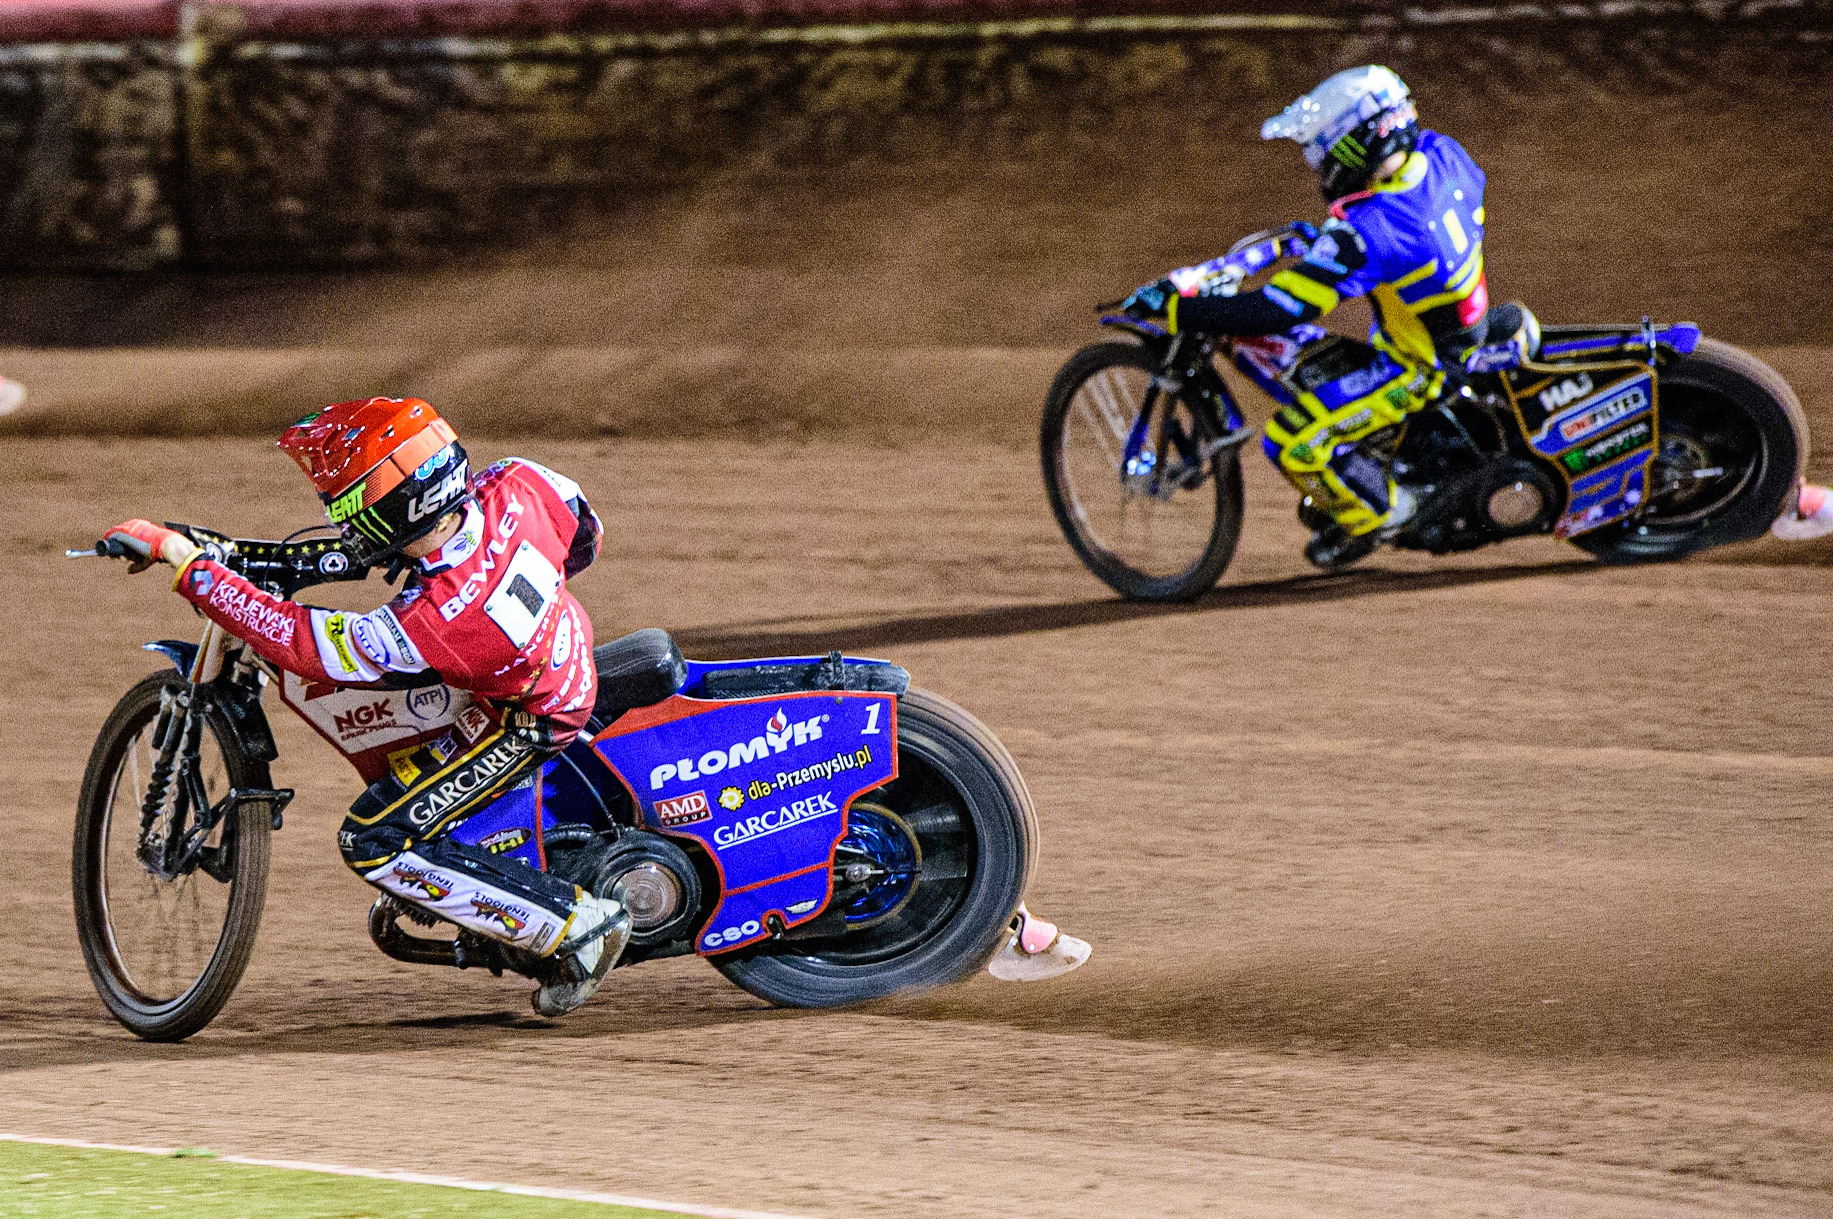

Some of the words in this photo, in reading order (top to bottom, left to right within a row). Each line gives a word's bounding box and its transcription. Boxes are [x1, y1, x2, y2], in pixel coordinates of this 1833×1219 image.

[439, 493, 524, 622] BEWLEY
[214, 580, 297, 633] KRAJEWSKI
[506, 573, 544, 618] 1
[209, 596, 294, 647] KONSTRUKCJE
[333, 698, 394, 733] NGK
[860, 702, 880, 735] 1
[409, 736, 531, 825] GARCAREK
[660, 795, 706, 819] AMD
[665, 811, 706, 825] GROUP
[713, 791, 837, 845] GARCAREK
[704, 920, 760, 947] CSO
